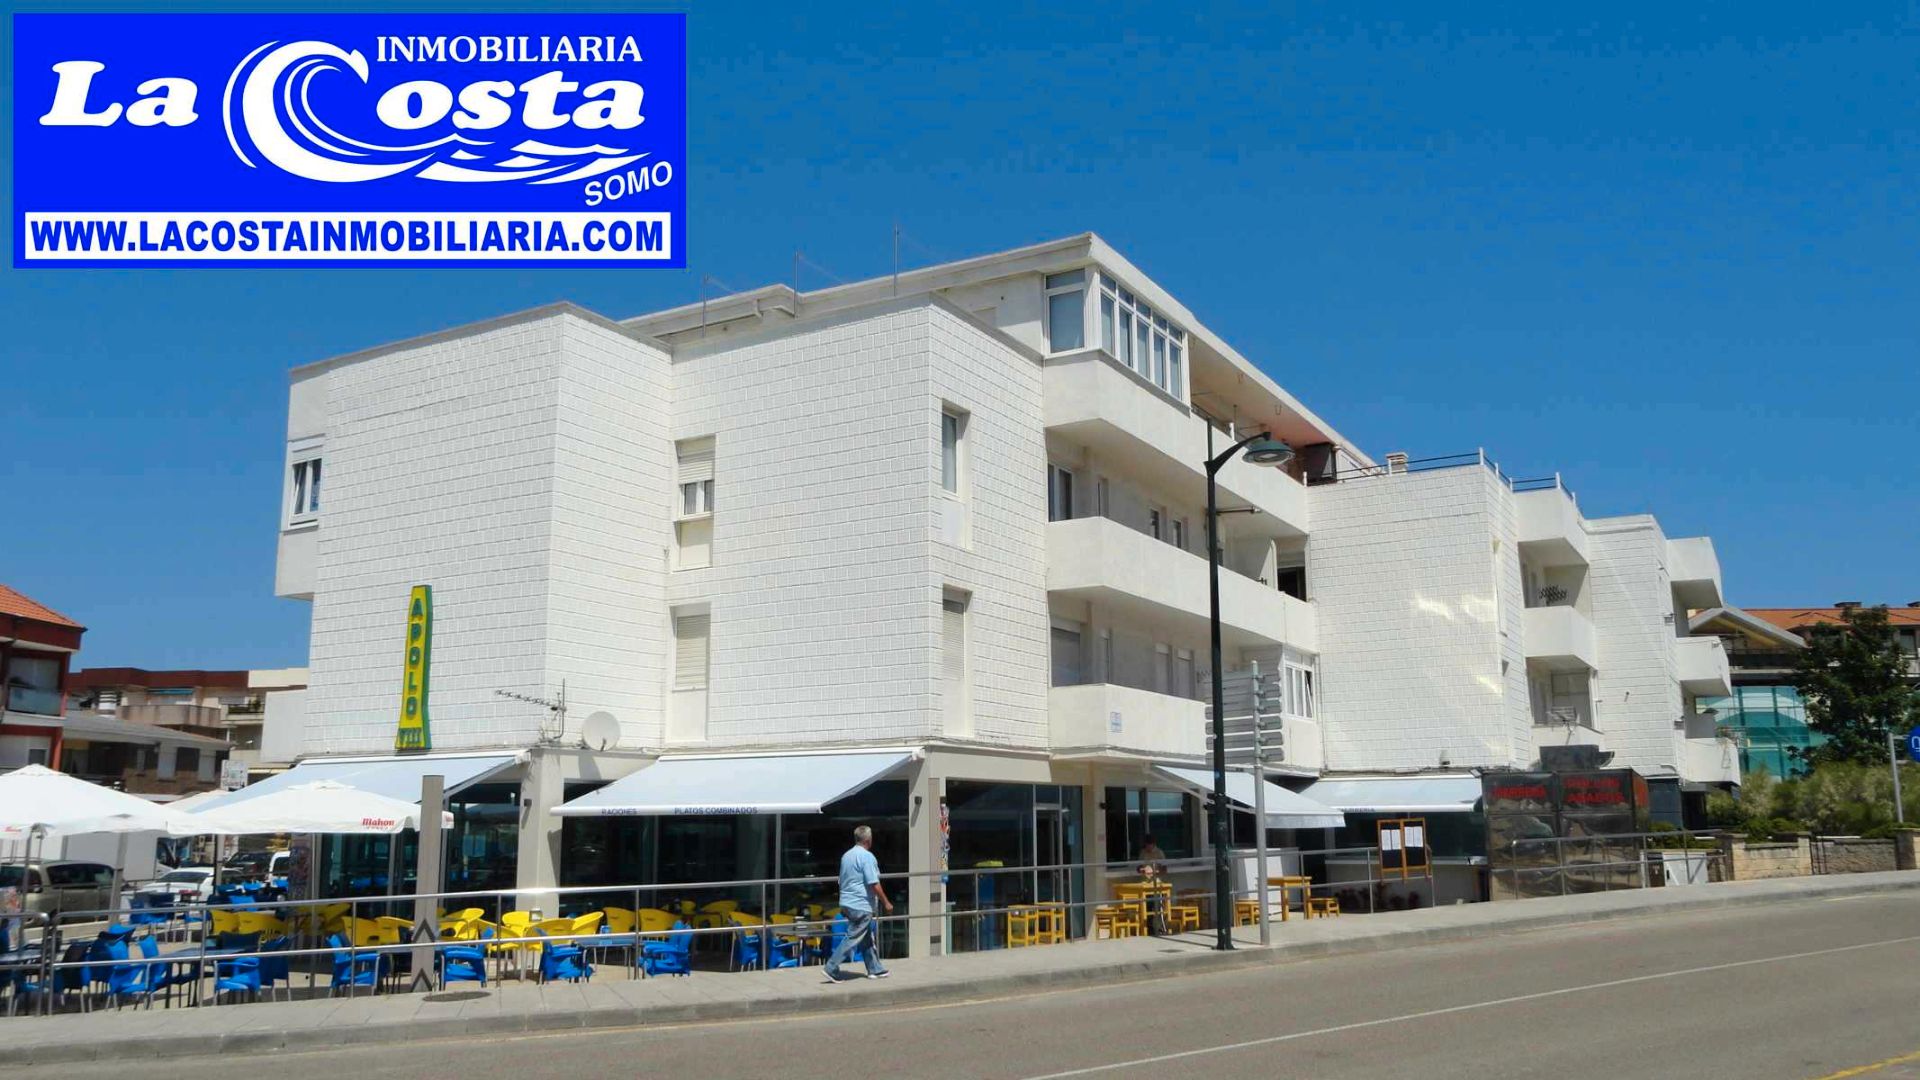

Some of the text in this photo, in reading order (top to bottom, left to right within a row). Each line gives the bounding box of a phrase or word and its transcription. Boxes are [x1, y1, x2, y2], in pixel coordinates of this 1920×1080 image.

[405, 598, 423, 717] APOLO
[674, 807, 703, 815] PLATOS
[705, 806, 758, 815] COMBINADOS
